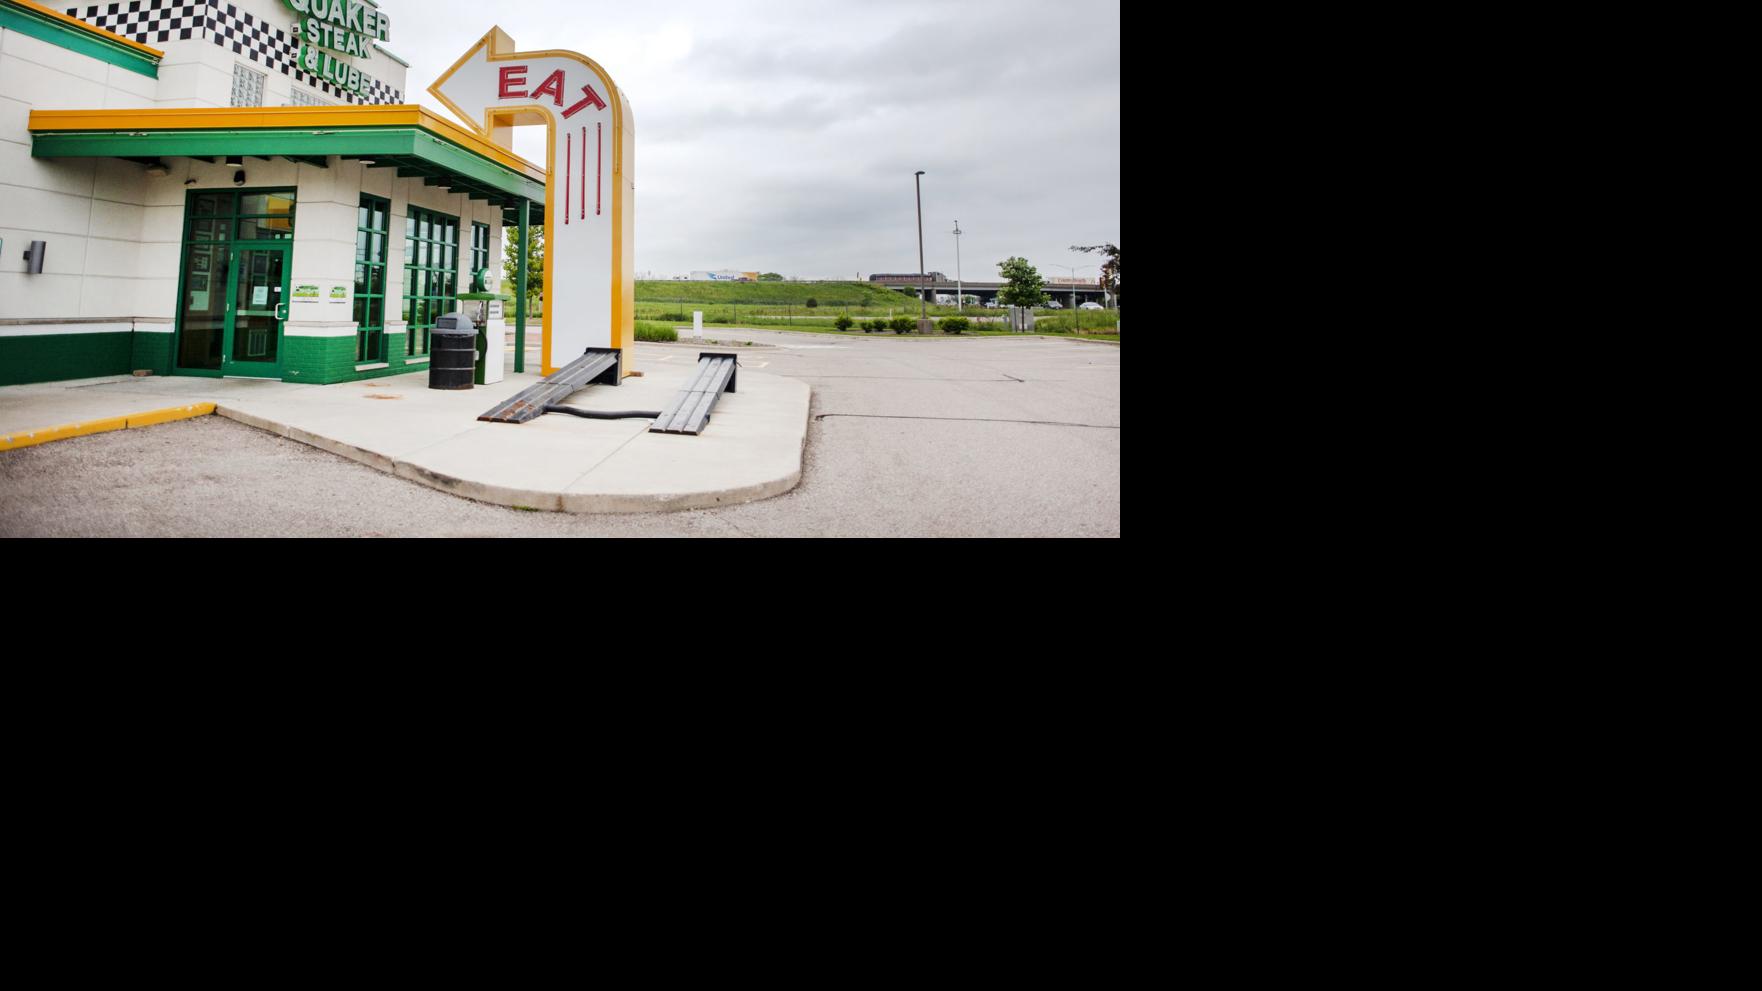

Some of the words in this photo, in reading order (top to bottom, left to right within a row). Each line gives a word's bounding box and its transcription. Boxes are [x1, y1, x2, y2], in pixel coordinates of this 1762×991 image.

[289, 0, 391, 42] QUAKER
[306, 17, 371, 59] STEAK
[304, 45, 319, 72] &
[322, 53, 372, 97] LUBE
[498, 65, 607, 119] EAT
